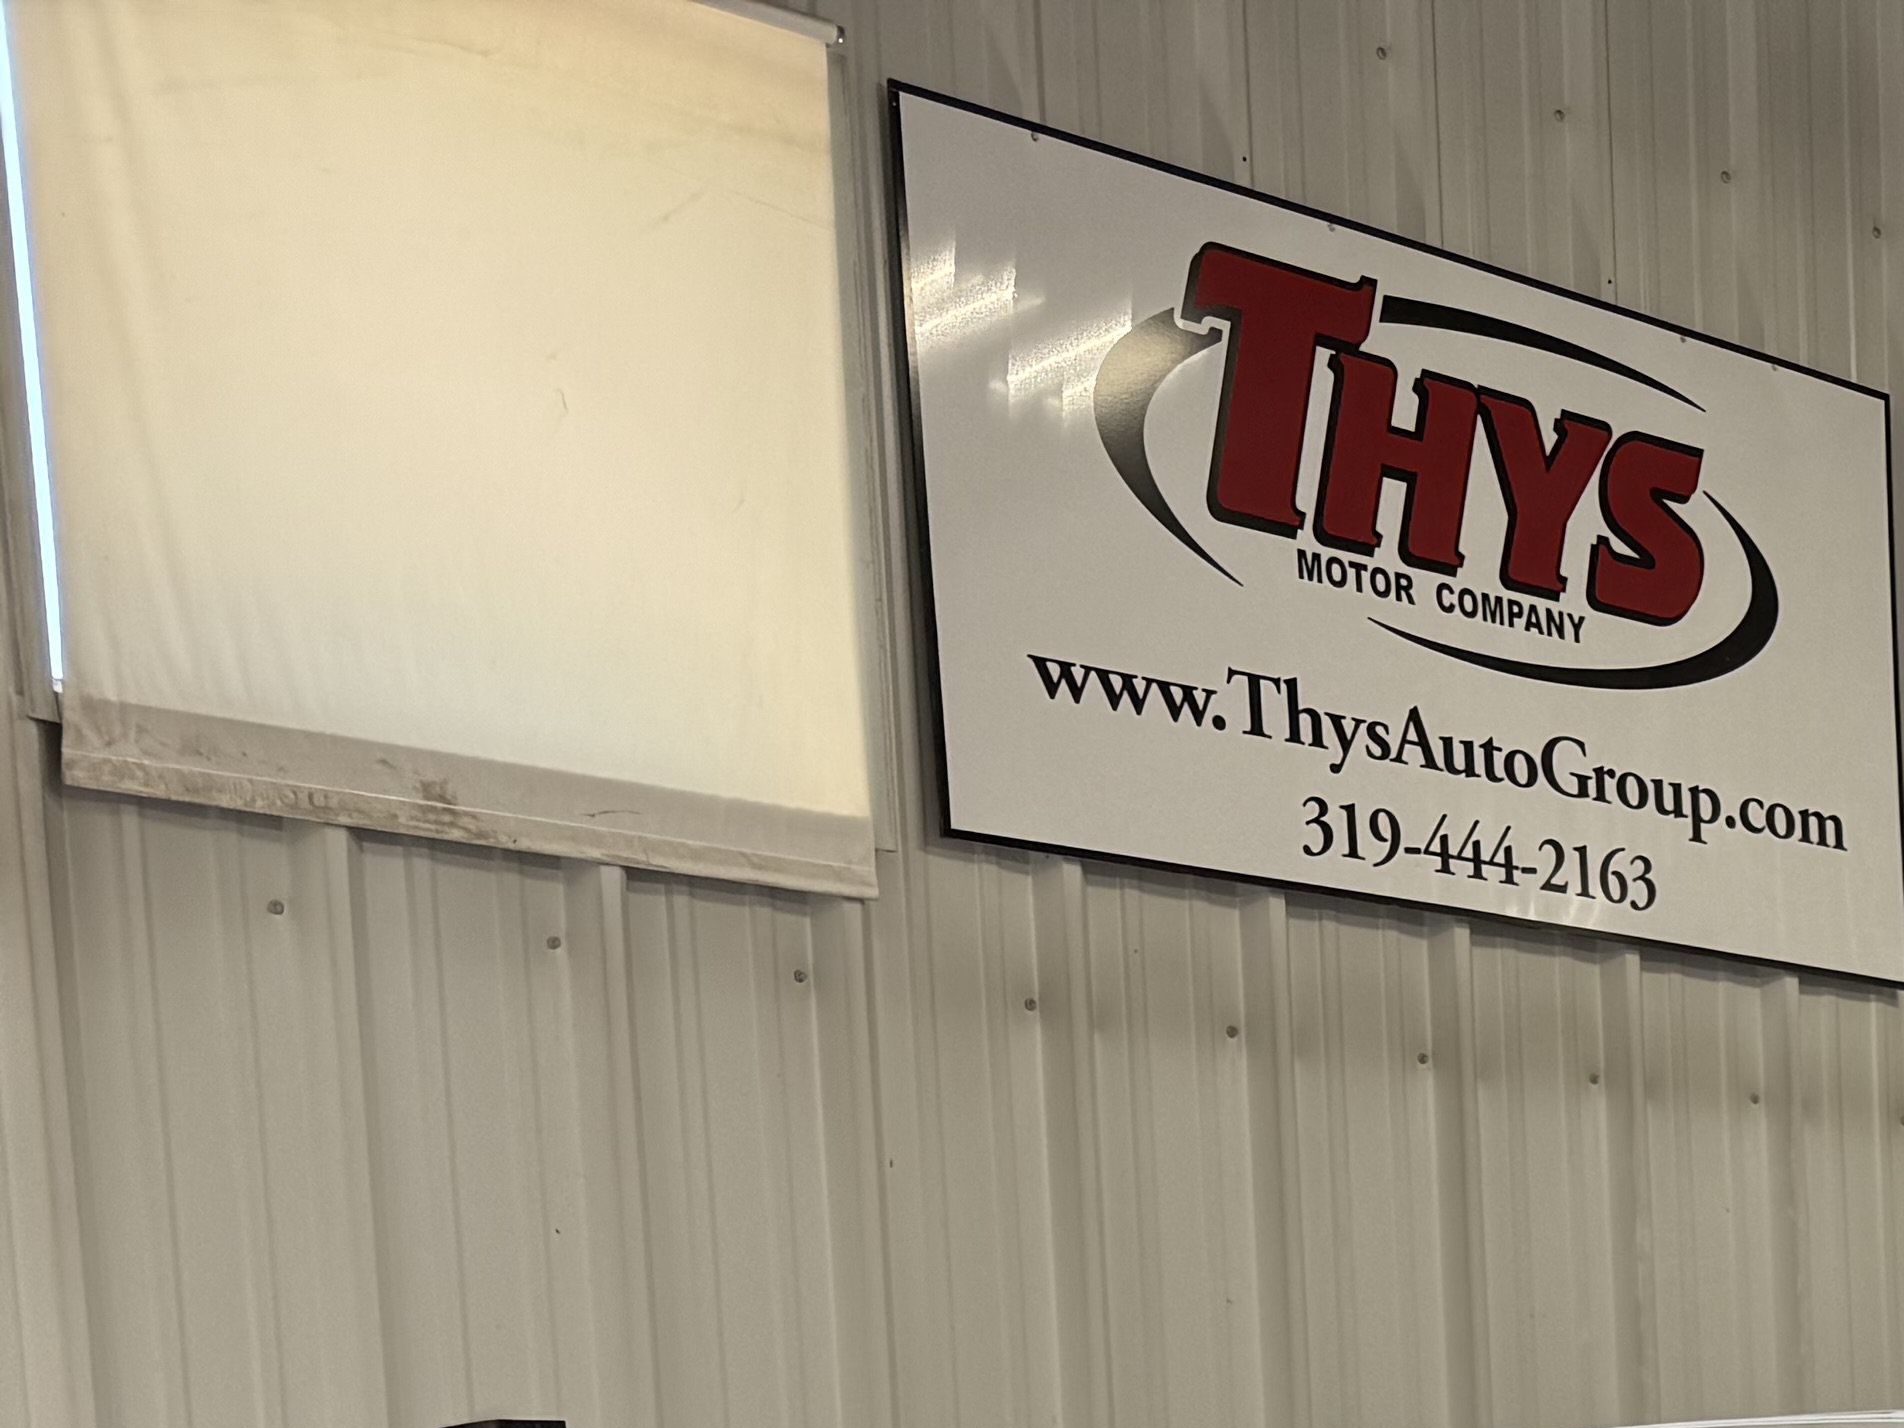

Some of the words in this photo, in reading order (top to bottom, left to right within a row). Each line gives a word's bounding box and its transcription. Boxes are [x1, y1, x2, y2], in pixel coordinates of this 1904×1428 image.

[1178, 241, 1705, 627] THYS
[1295, 547, 1415, 605] MOTOR
[1435, 581, 1586, 644] COMPANY
[1027, 652, 1848, 852] www.ThysAutoGroup.com
[1301, 795, 1658, 911] 319-444-2163
